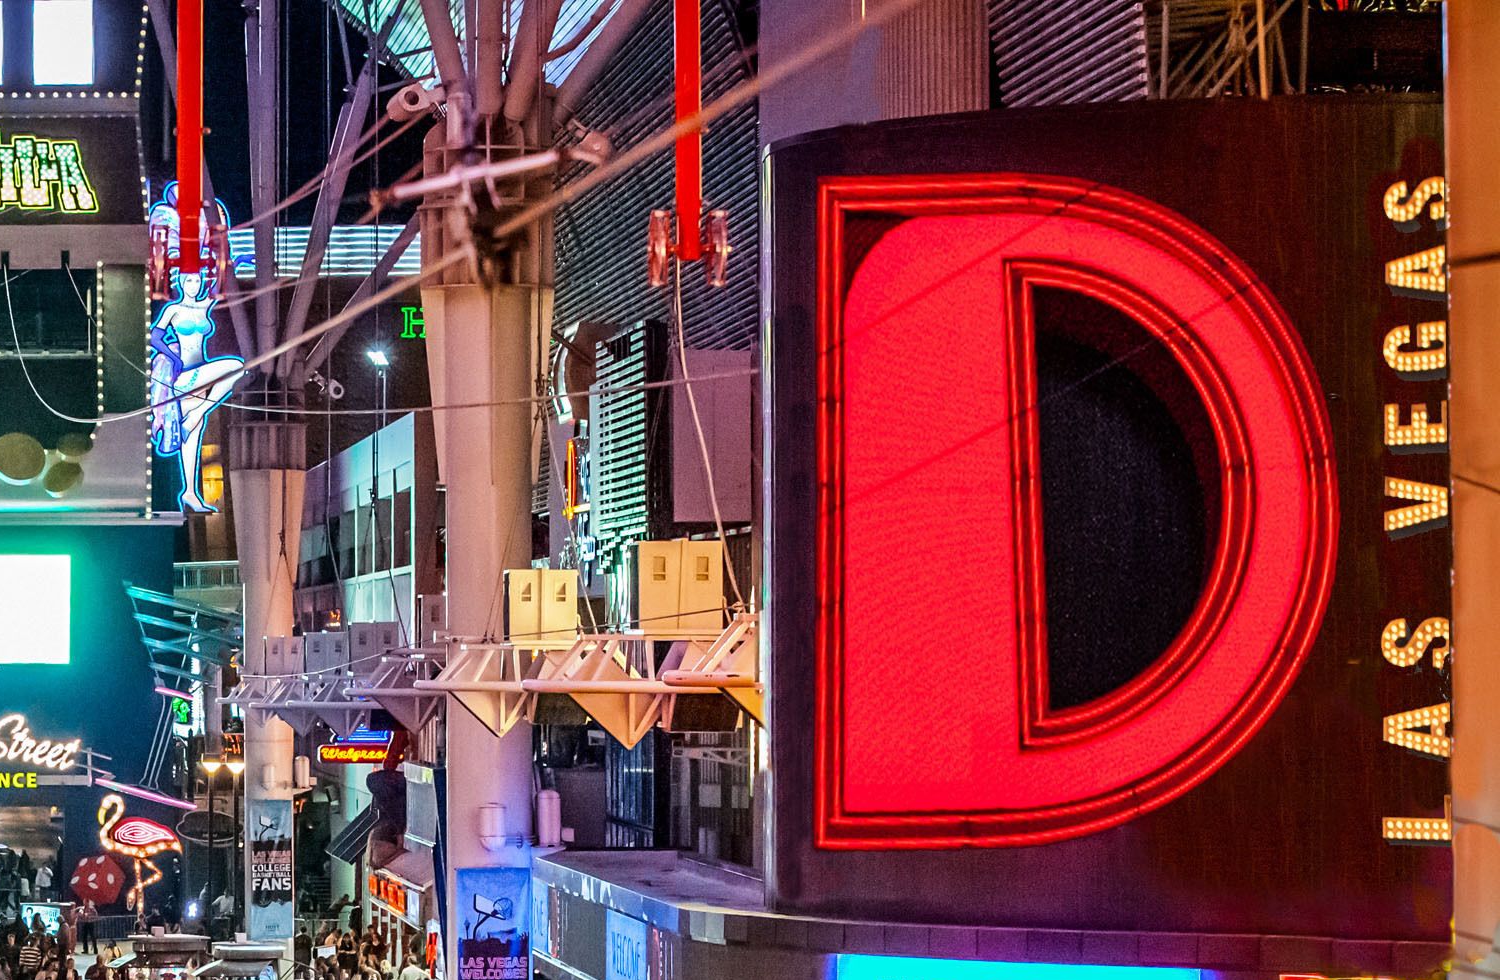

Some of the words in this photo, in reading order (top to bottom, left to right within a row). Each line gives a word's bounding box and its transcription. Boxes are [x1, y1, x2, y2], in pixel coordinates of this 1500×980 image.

[1382, 174, 1449, 532] VEGAS
[1382, 616, 1452, 842] LAS
[251, 864, 291, 872] COLLEGE
[252, 878, 292, 891] FANS
[459, 957, 485, 968] LAS
[487, 957, 527, 968] VEGAS
[460, 968, 527, 980] WELCOMES
